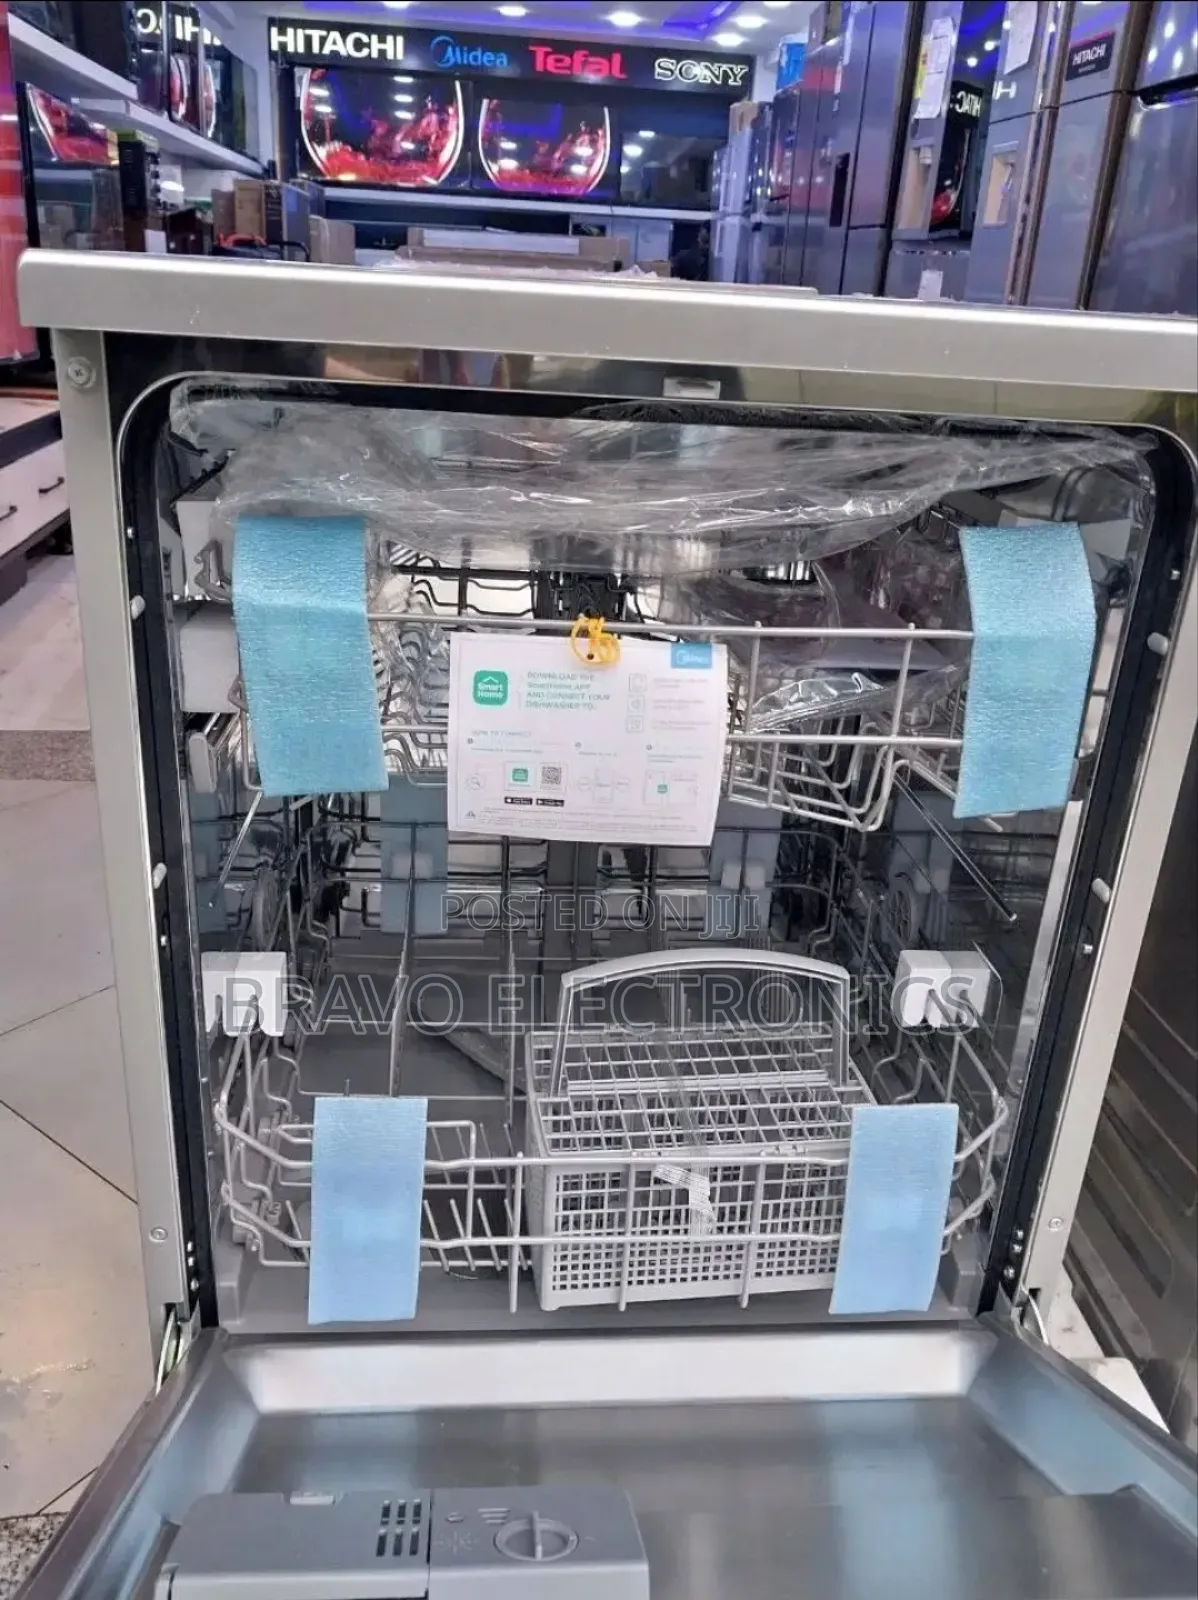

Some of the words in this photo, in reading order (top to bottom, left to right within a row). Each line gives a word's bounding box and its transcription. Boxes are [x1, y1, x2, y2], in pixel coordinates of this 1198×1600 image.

[269, 26, 404, 61] HITACHI
[430, 35, 509, 69] Midea
[1072, 44, 1106, 66] HITACHI
[529, 45, 627, 80] Tefal
[654, 57, 749, 87] SONY
[477, 682, 503, 692] Smart
[477, 691, 504, 699] Home
